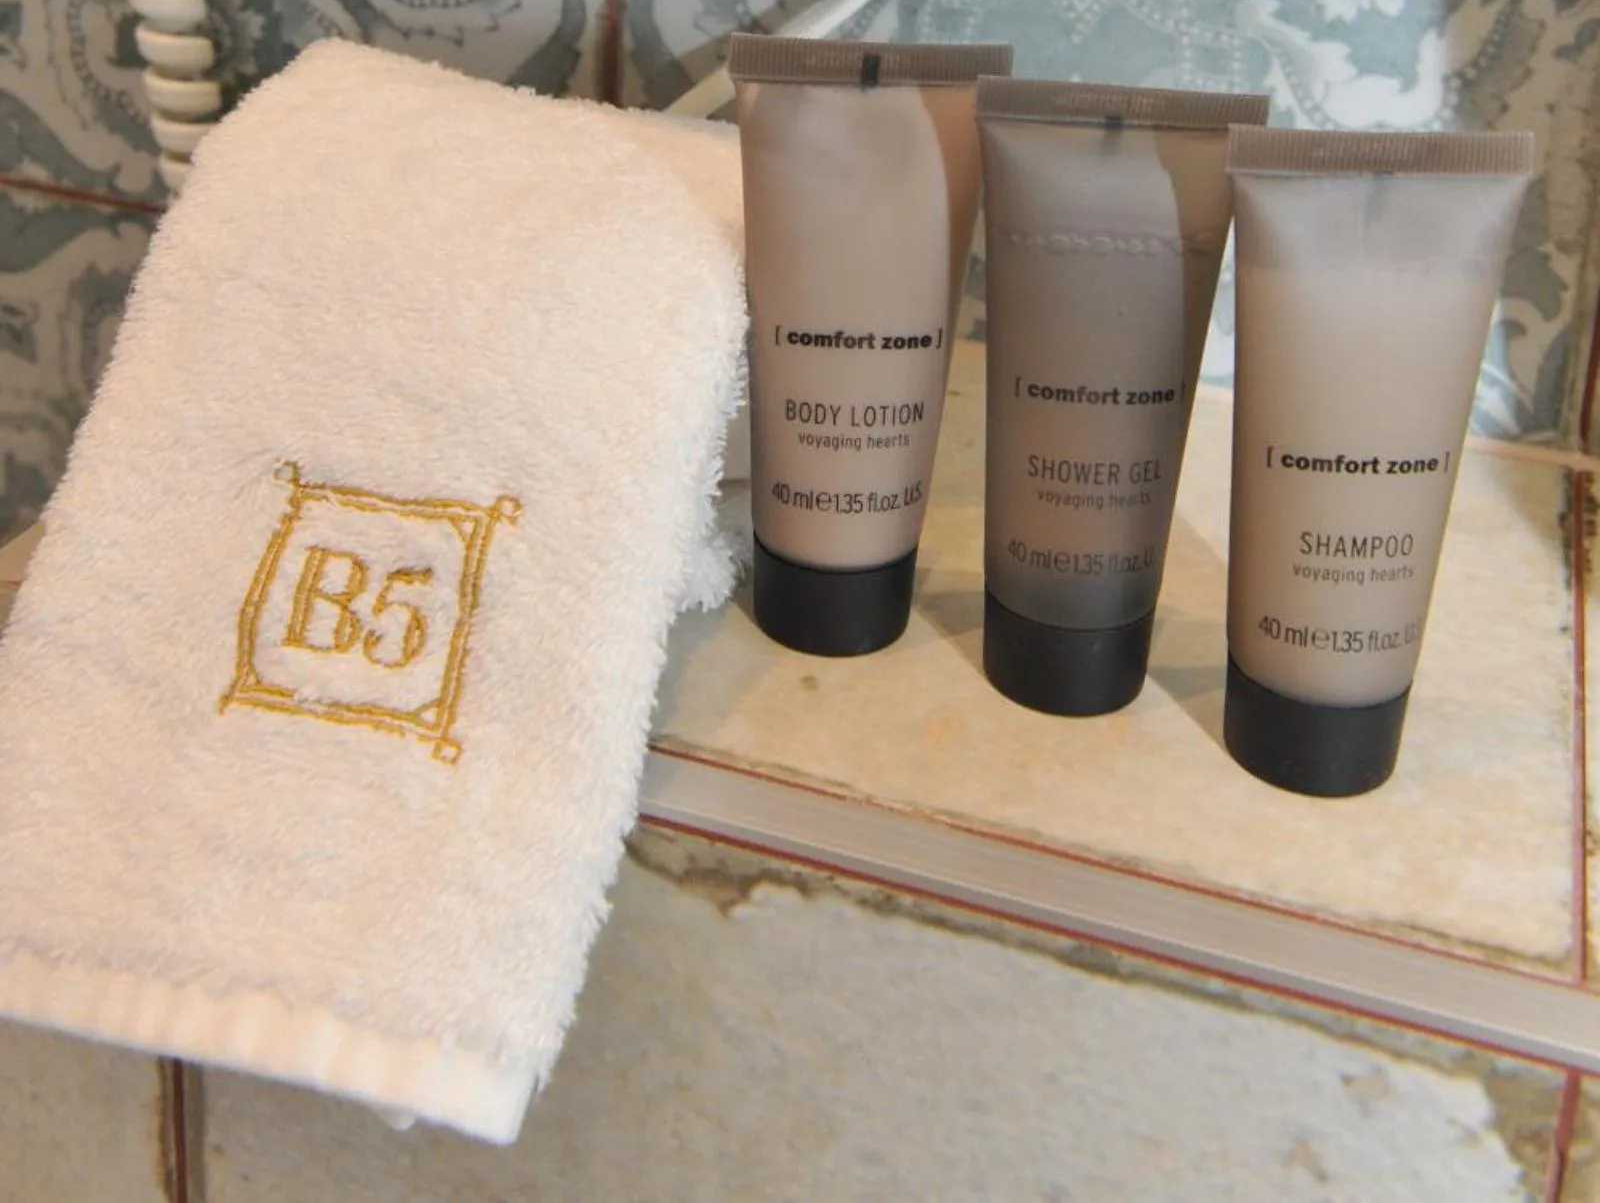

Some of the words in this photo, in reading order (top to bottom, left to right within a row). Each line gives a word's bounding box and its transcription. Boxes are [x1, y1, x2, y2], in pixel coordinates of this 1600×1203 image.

[786, 399, 841, 426] BODY
[852, 401, 924, 427] LOTION
[798, 432, 861, 451] voyaging
[867, 433, 910, 448] hearts
[1028, 455, 1120, 485] SHOWER
[1129, 459, 1162, 485] GEL
[1037, 490, 1104, 510] voyaging
[1300, 531, 1413, 558] SHAMPOO
[1292, 563, 1365, 585] voyaging
[1370, 565, 1414, 582] hearts
[280, 545, 434, 669] B5
